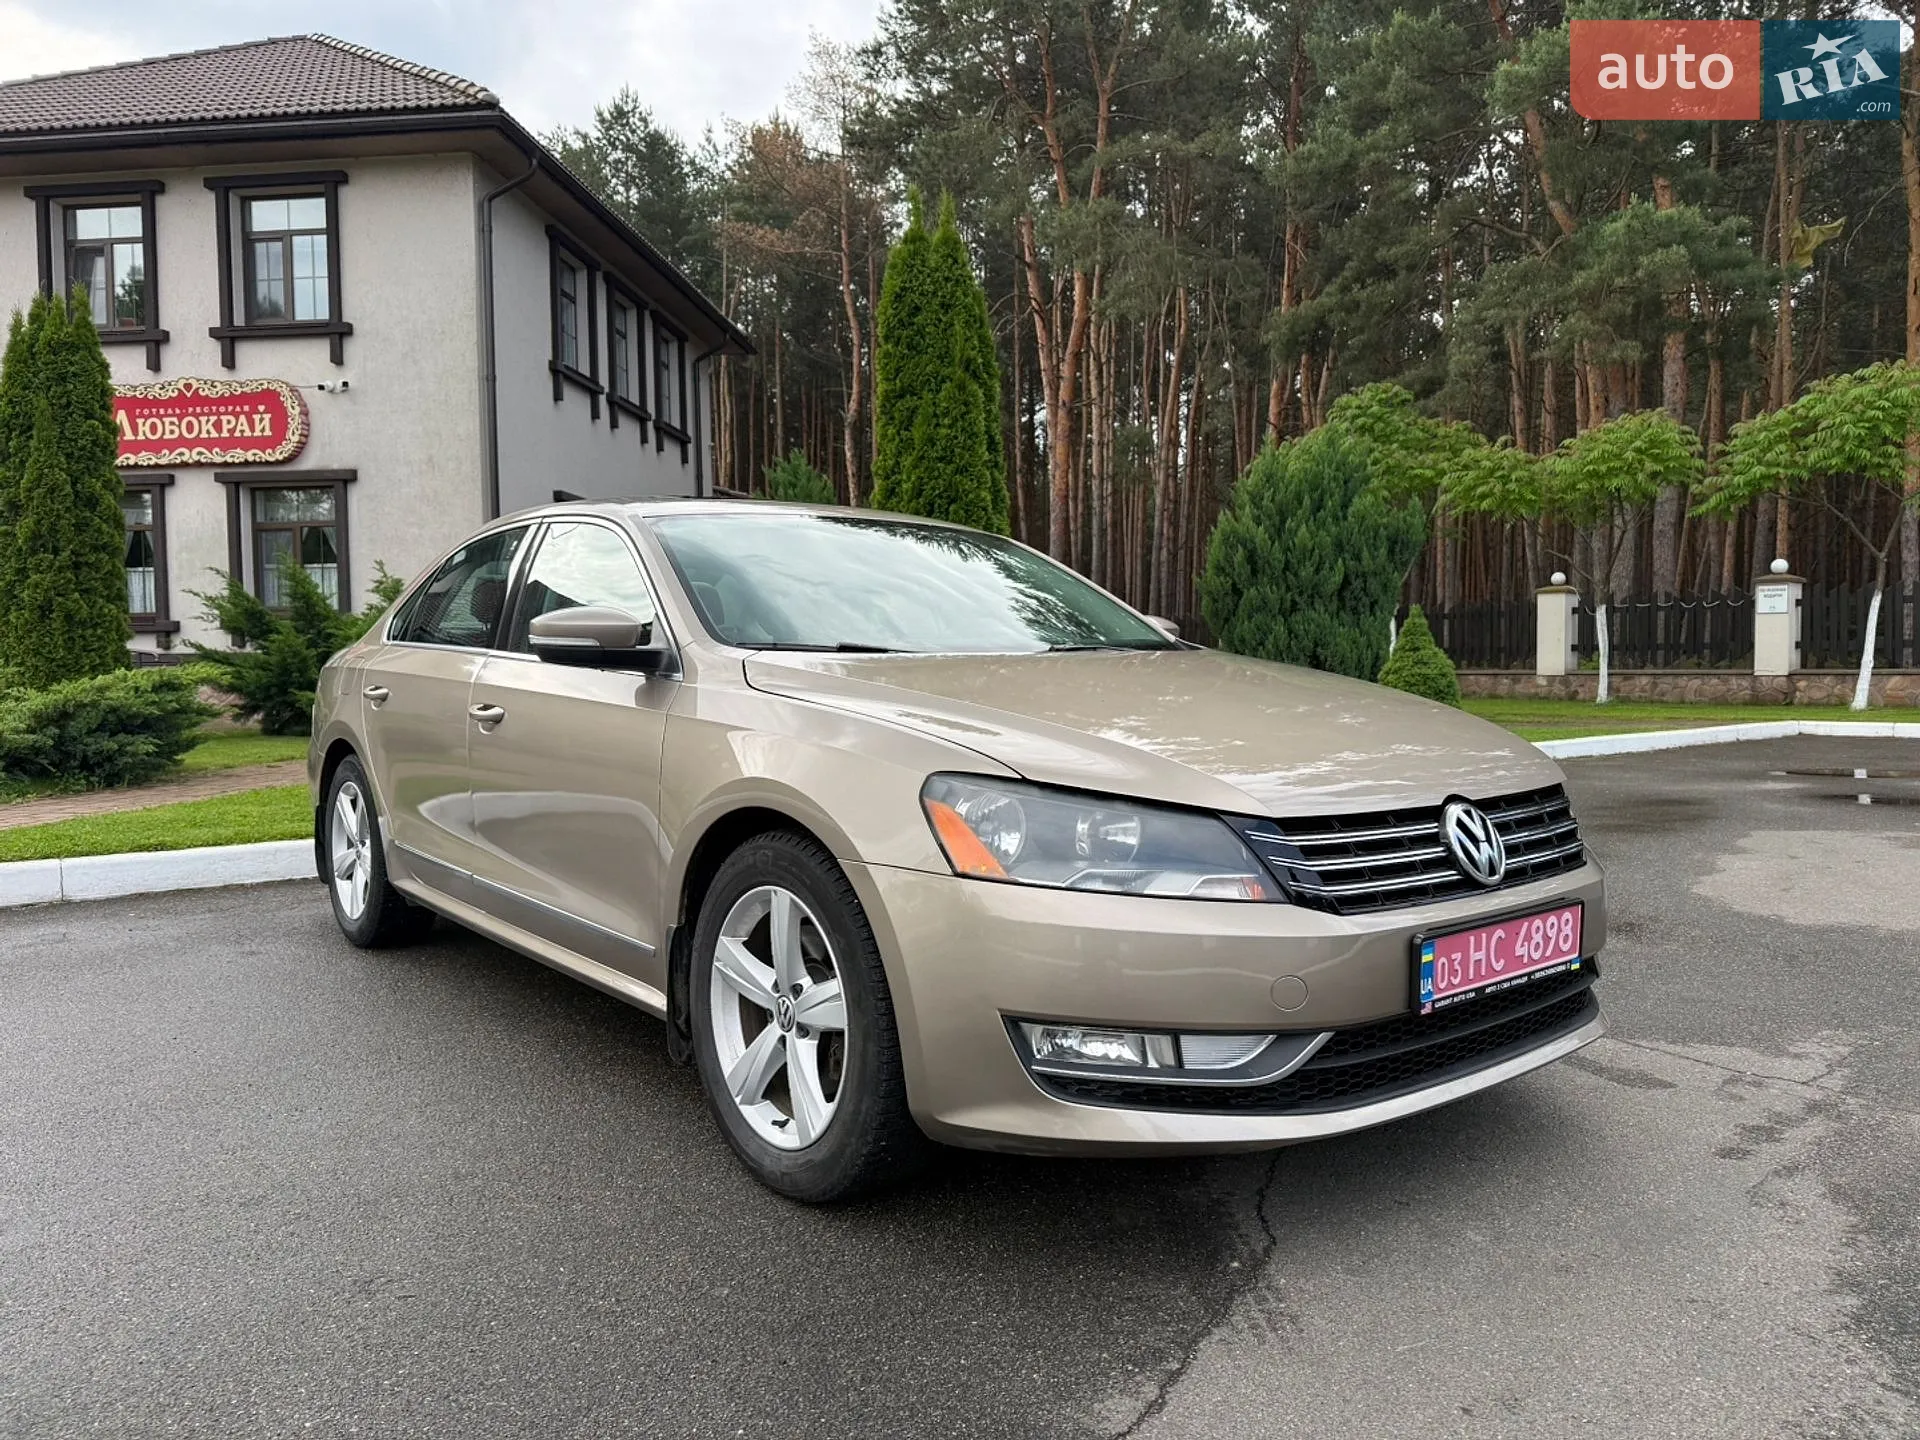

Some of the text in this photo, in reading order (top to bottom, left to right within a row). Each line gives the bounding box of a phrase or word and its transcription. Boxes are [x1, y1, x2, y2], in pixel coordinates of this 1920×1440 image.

[1437, 952, 1462, 990] 03
[1514, 911, 1574, 964] 4898
[1420, 978, 1434, 994] UA
